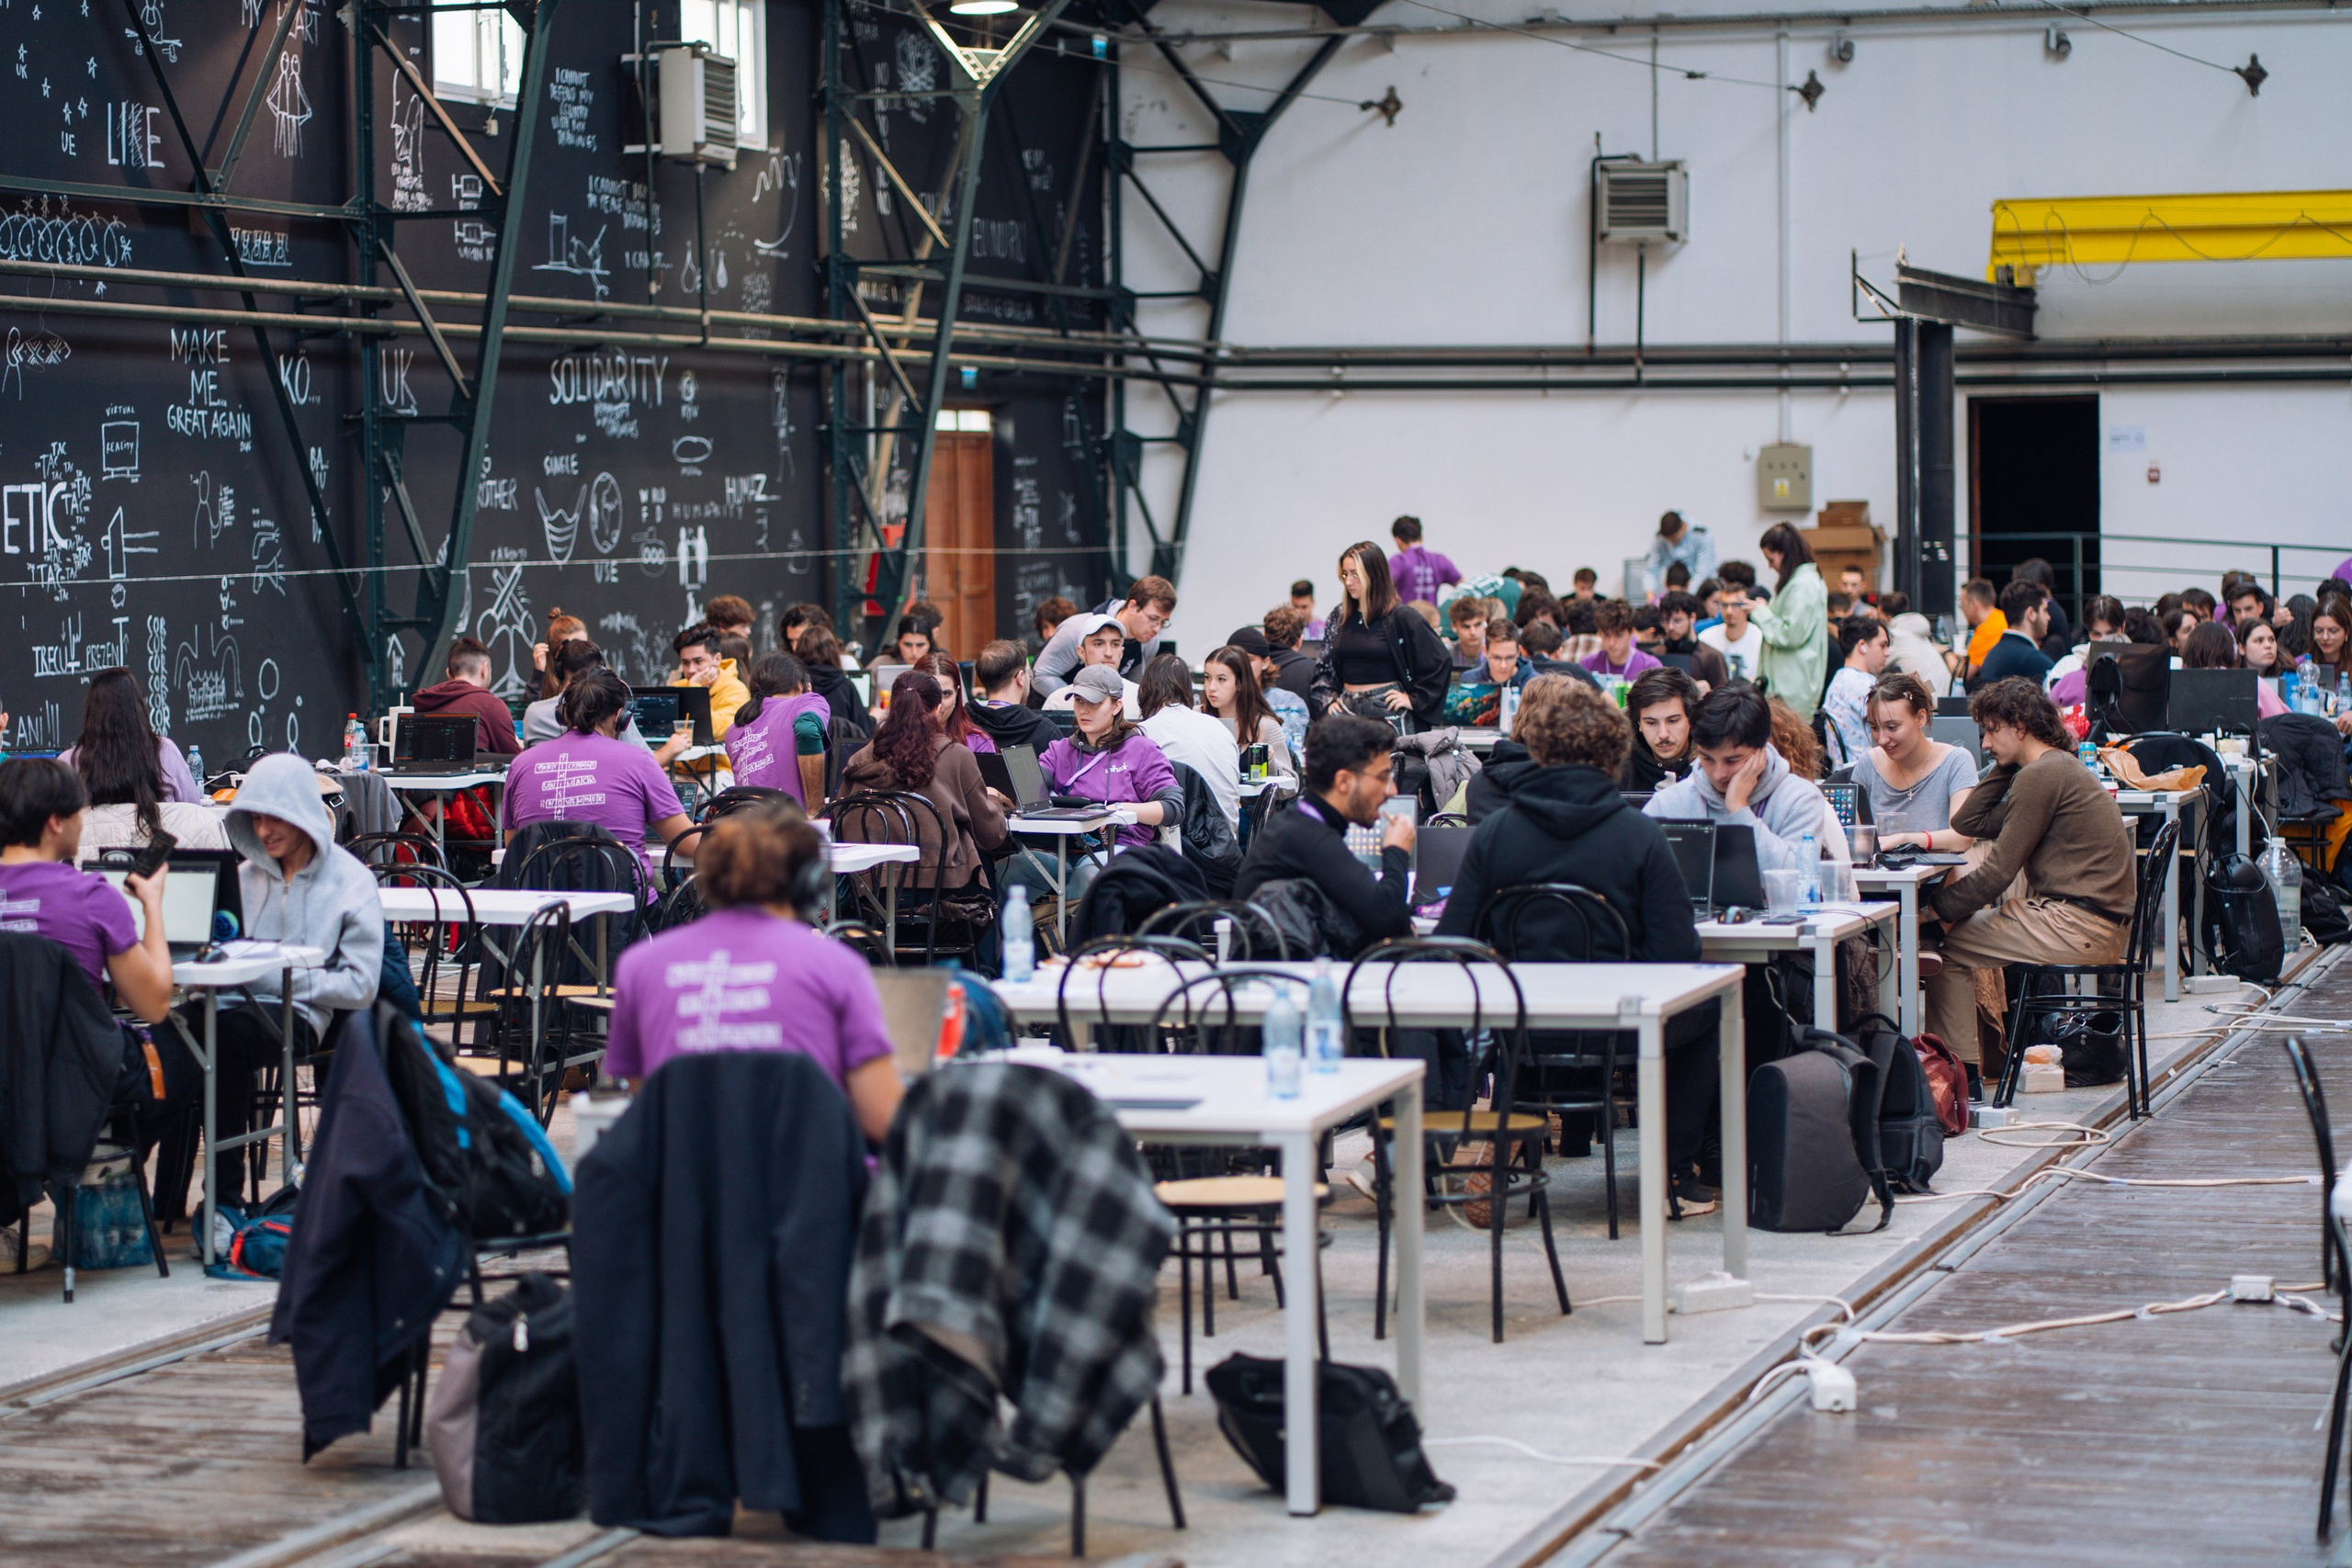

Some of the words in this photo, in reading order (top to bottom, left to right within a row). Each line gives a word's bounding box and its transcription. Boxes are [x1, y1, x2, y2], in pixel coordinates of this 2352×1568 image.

[16, 63, 28, 79] UK
[62, 130, 76, 156] UE
[171, 328, 230, 365] MAKE
[381, 348, 417, 406] UK
[549, 354, 668, 405] SOLIDARITY
[167, 404, 208, 439] GREAT
[211, 404, 252, 439] AGAIN
[40, 454, 58, 479] TAC
[62, 491, 85, 515] TAC
[4, 481, 67, 553] ETIC
[37, 564, 62, 592] TAC
[594, 560, 619, 583] USE
[150, 706, 171, 728] COR
